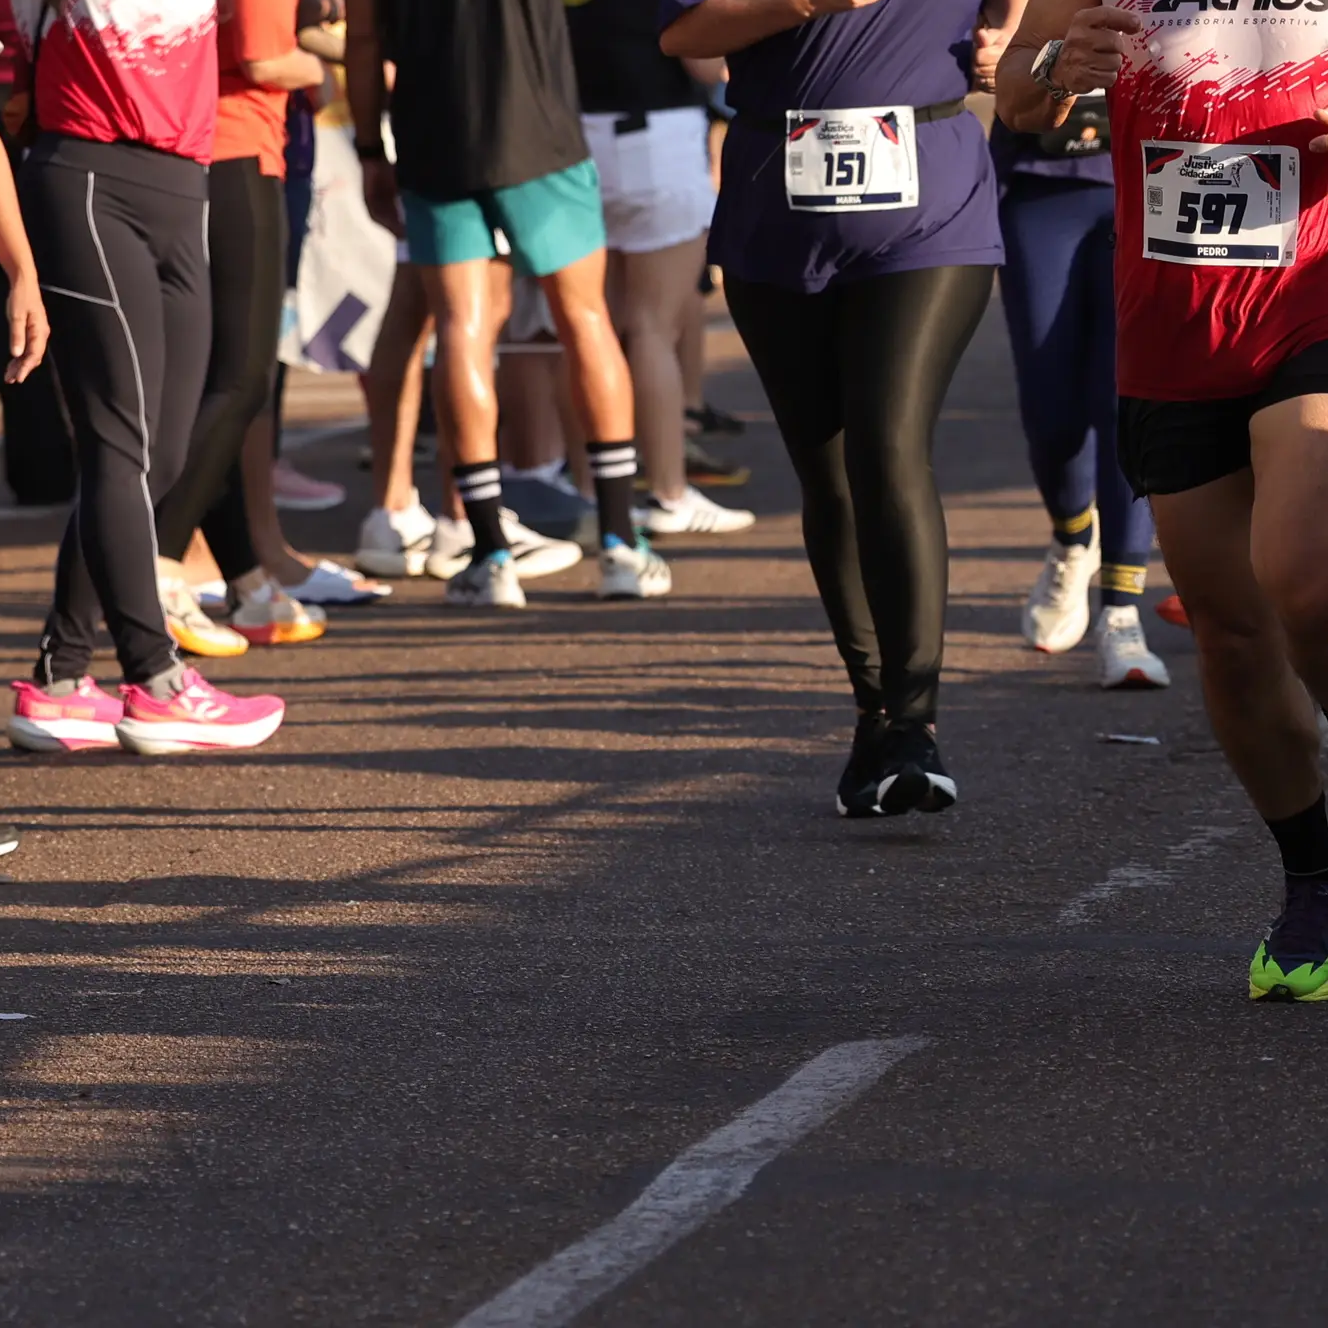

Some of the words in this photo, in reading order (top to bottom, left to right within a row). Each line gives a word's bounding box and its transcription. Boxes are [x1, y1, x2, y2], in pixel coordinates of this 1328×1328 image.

[1150, 18, 1234, 27] ASSESSORIA
[1243, 17, 1318, 27] ESPORTIVA
[824, 152, 866, 186] 151
[1183, 155, 1224, 172] Justiça
[1179, 168, 1224, 179] Cidadania
[1176, 191, 1248, 234] 597
[1197, 247, 1228, 256] PEDRO
